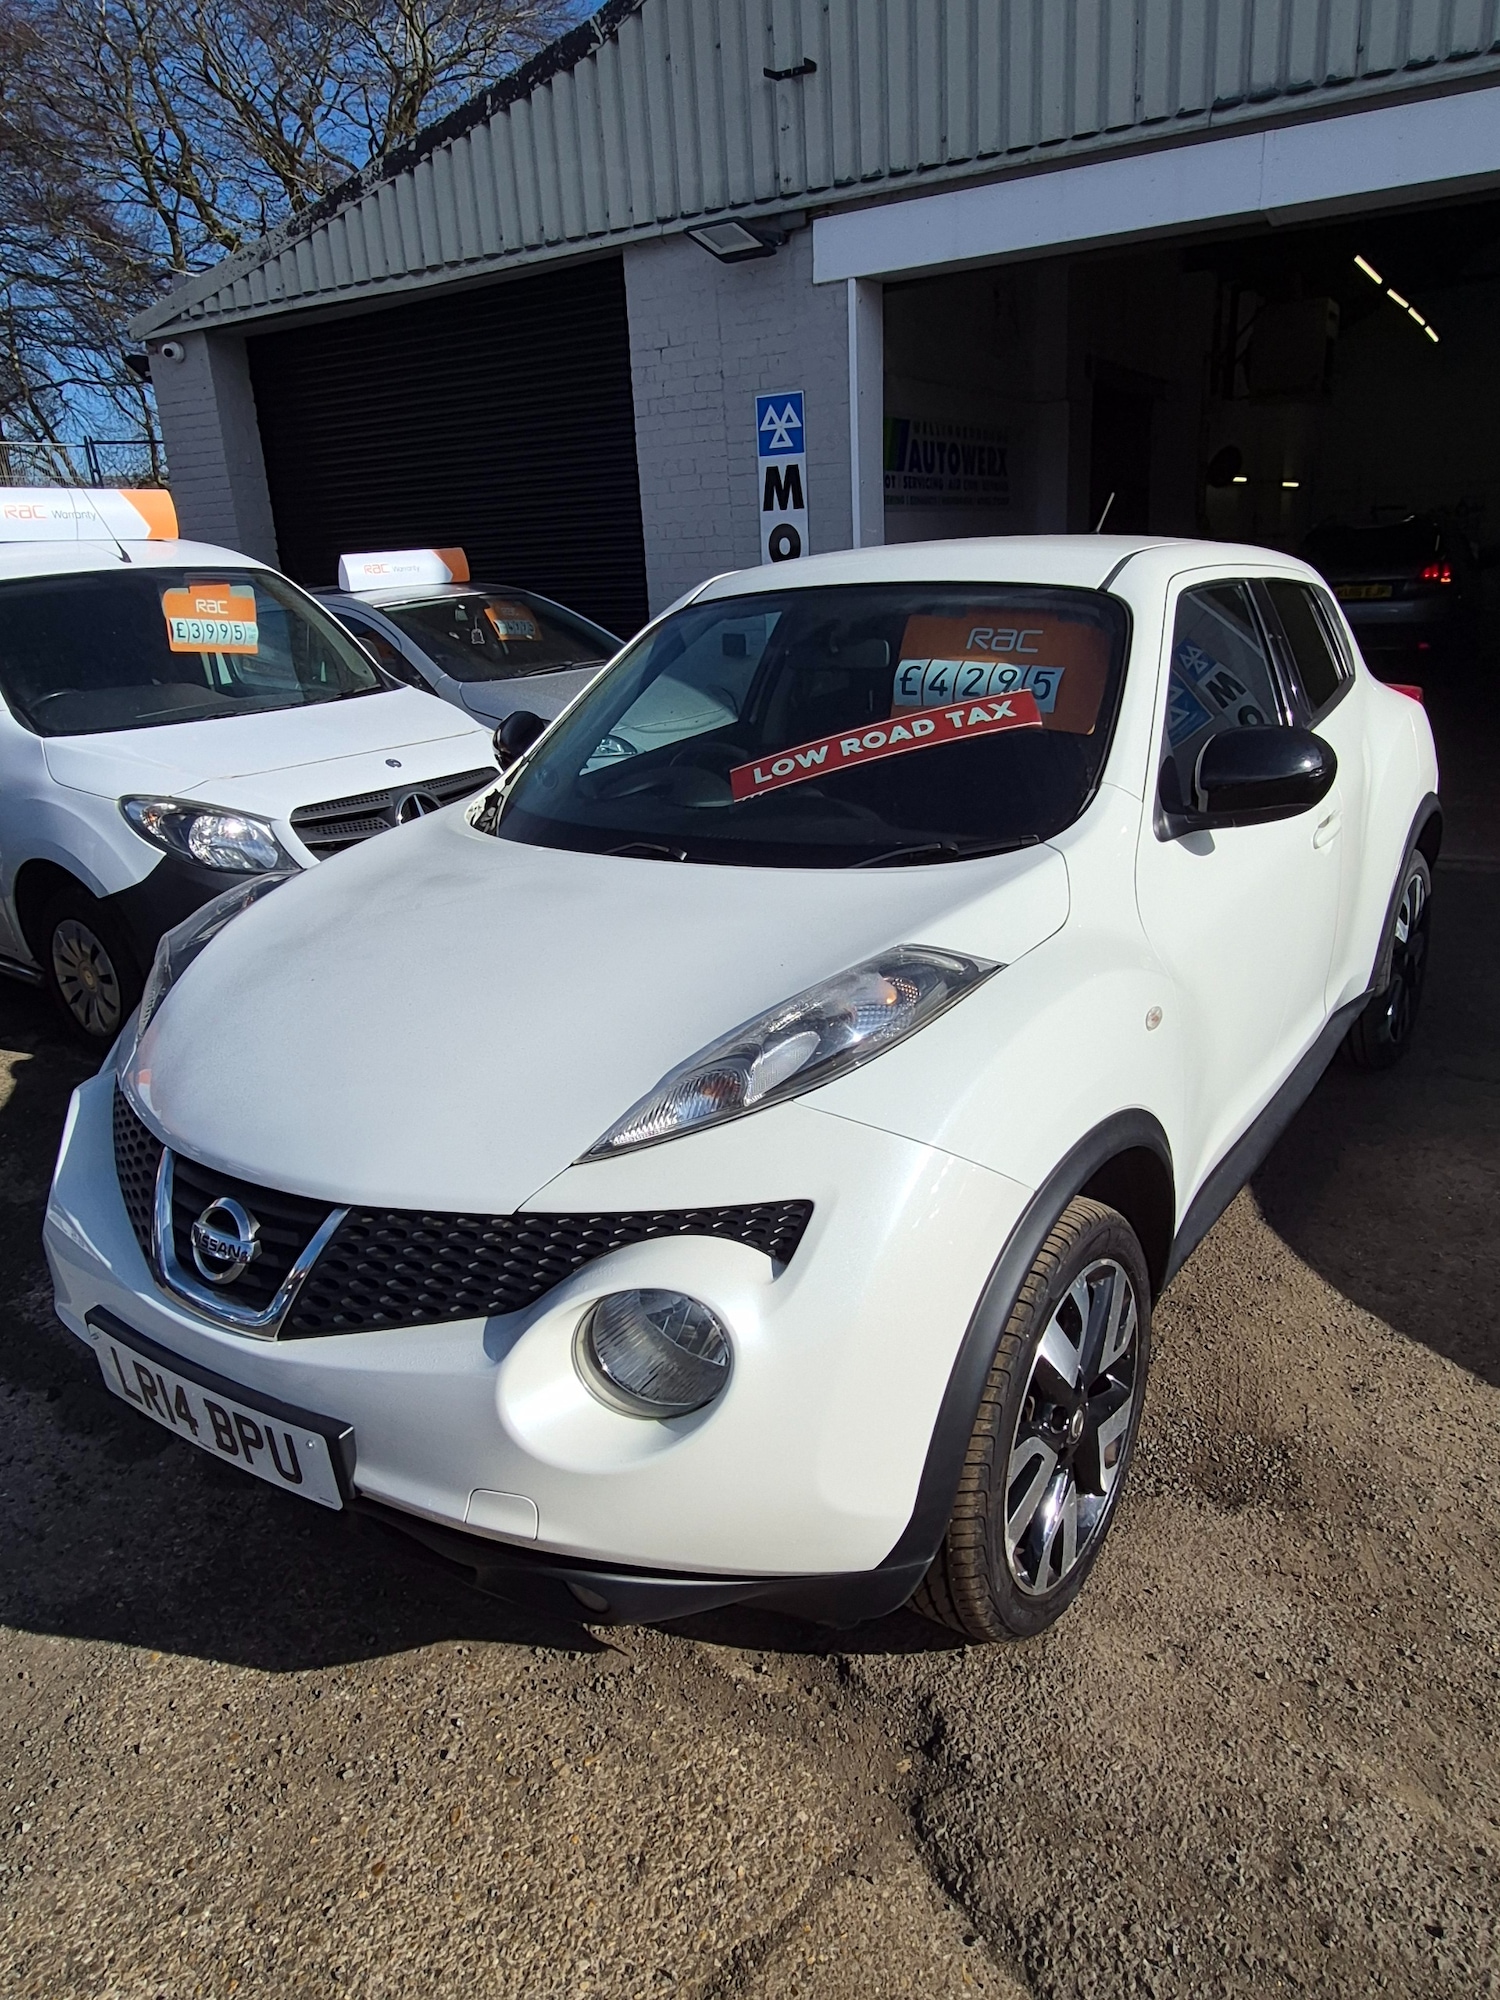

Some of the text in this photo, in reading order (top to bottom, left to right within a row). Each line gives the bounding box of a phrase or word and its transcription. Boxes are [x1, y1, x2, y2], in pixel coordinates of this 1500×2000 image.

[908, 439, 1008, 477] AUTOWERX
[885, 474, 895, 489] OT
[903, 476, 944, 490] SERVICING
[51, 509, 97, 522] Warranty
[763, 463, 805, 563] MO
[176, 621, 244, 641] £3995
[899, 665, 1056, 701] £4295
[752, 698, 1018, 785] LOW ROAD TAX
[193, 1224, 241, 1258] NISSAN
[110, 1345, 303, 1485] LR14 BPU
